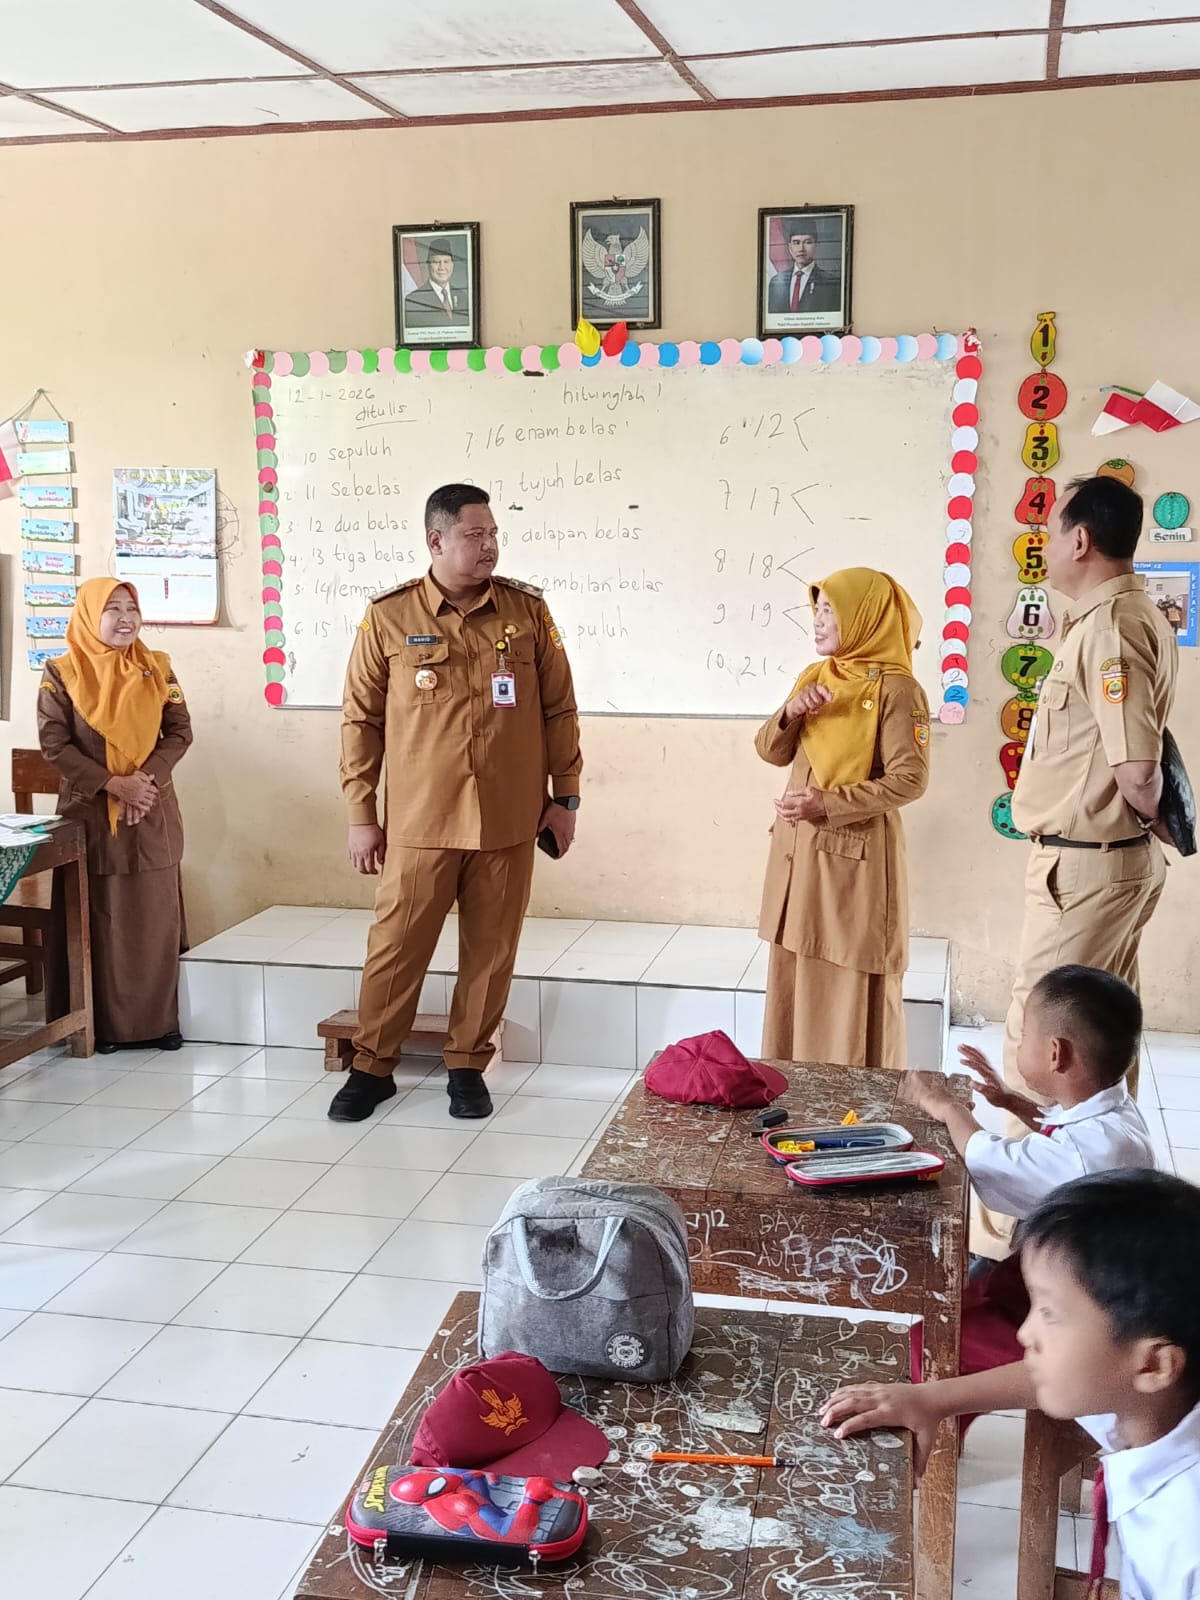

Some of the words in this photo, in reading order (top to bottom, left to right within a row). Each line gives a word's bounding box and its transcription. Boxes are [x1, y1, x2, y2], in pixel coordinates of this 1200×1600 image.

[1039, 323, 1049, 348] 1
[1031, 385, 1050, 410] 2
[486, 424, 505, 449] 16
[720, 425, 731, 445] 6
[754, 412, 785, 439] 12
[304, 451, 317, 465] 10
[1031, 436, 1049, 462] 3
[489, 480, 503, 501] 17
[519, 462, 564, 501] tujuh
[573, 458, 623, 487] belas
[718, 479, 732, 511] 7
[750, 486, 781, 516] 17
[1029, 491, 1046, 515] 4
[309, 516, 325, 533] 12
[334, 513, 360, 533] dua
[367, 510, 409, 531] belas
[521, 521, 588, 551] delapan
[595, 515, 643, 541] belas
[312, 546, 325, 566] 13
[334, 543, 367, 573] tiga
[374, 540, 416, 564] belas
[714, 548, 727, 573] 8
[748, 552, 774, 579] 18
[1026, 546, 1043, 569] 5
[618, 568, 664, 594] belas
[712, 602, 726, 625] 9
[750, 602, 773, 628] 19
[1023, 603, 1041, 627] 6
[314, 621, 332, 639] 15
[1019, 655, 1038, 678] 7
[1016, 707, 1034, 731] 8
